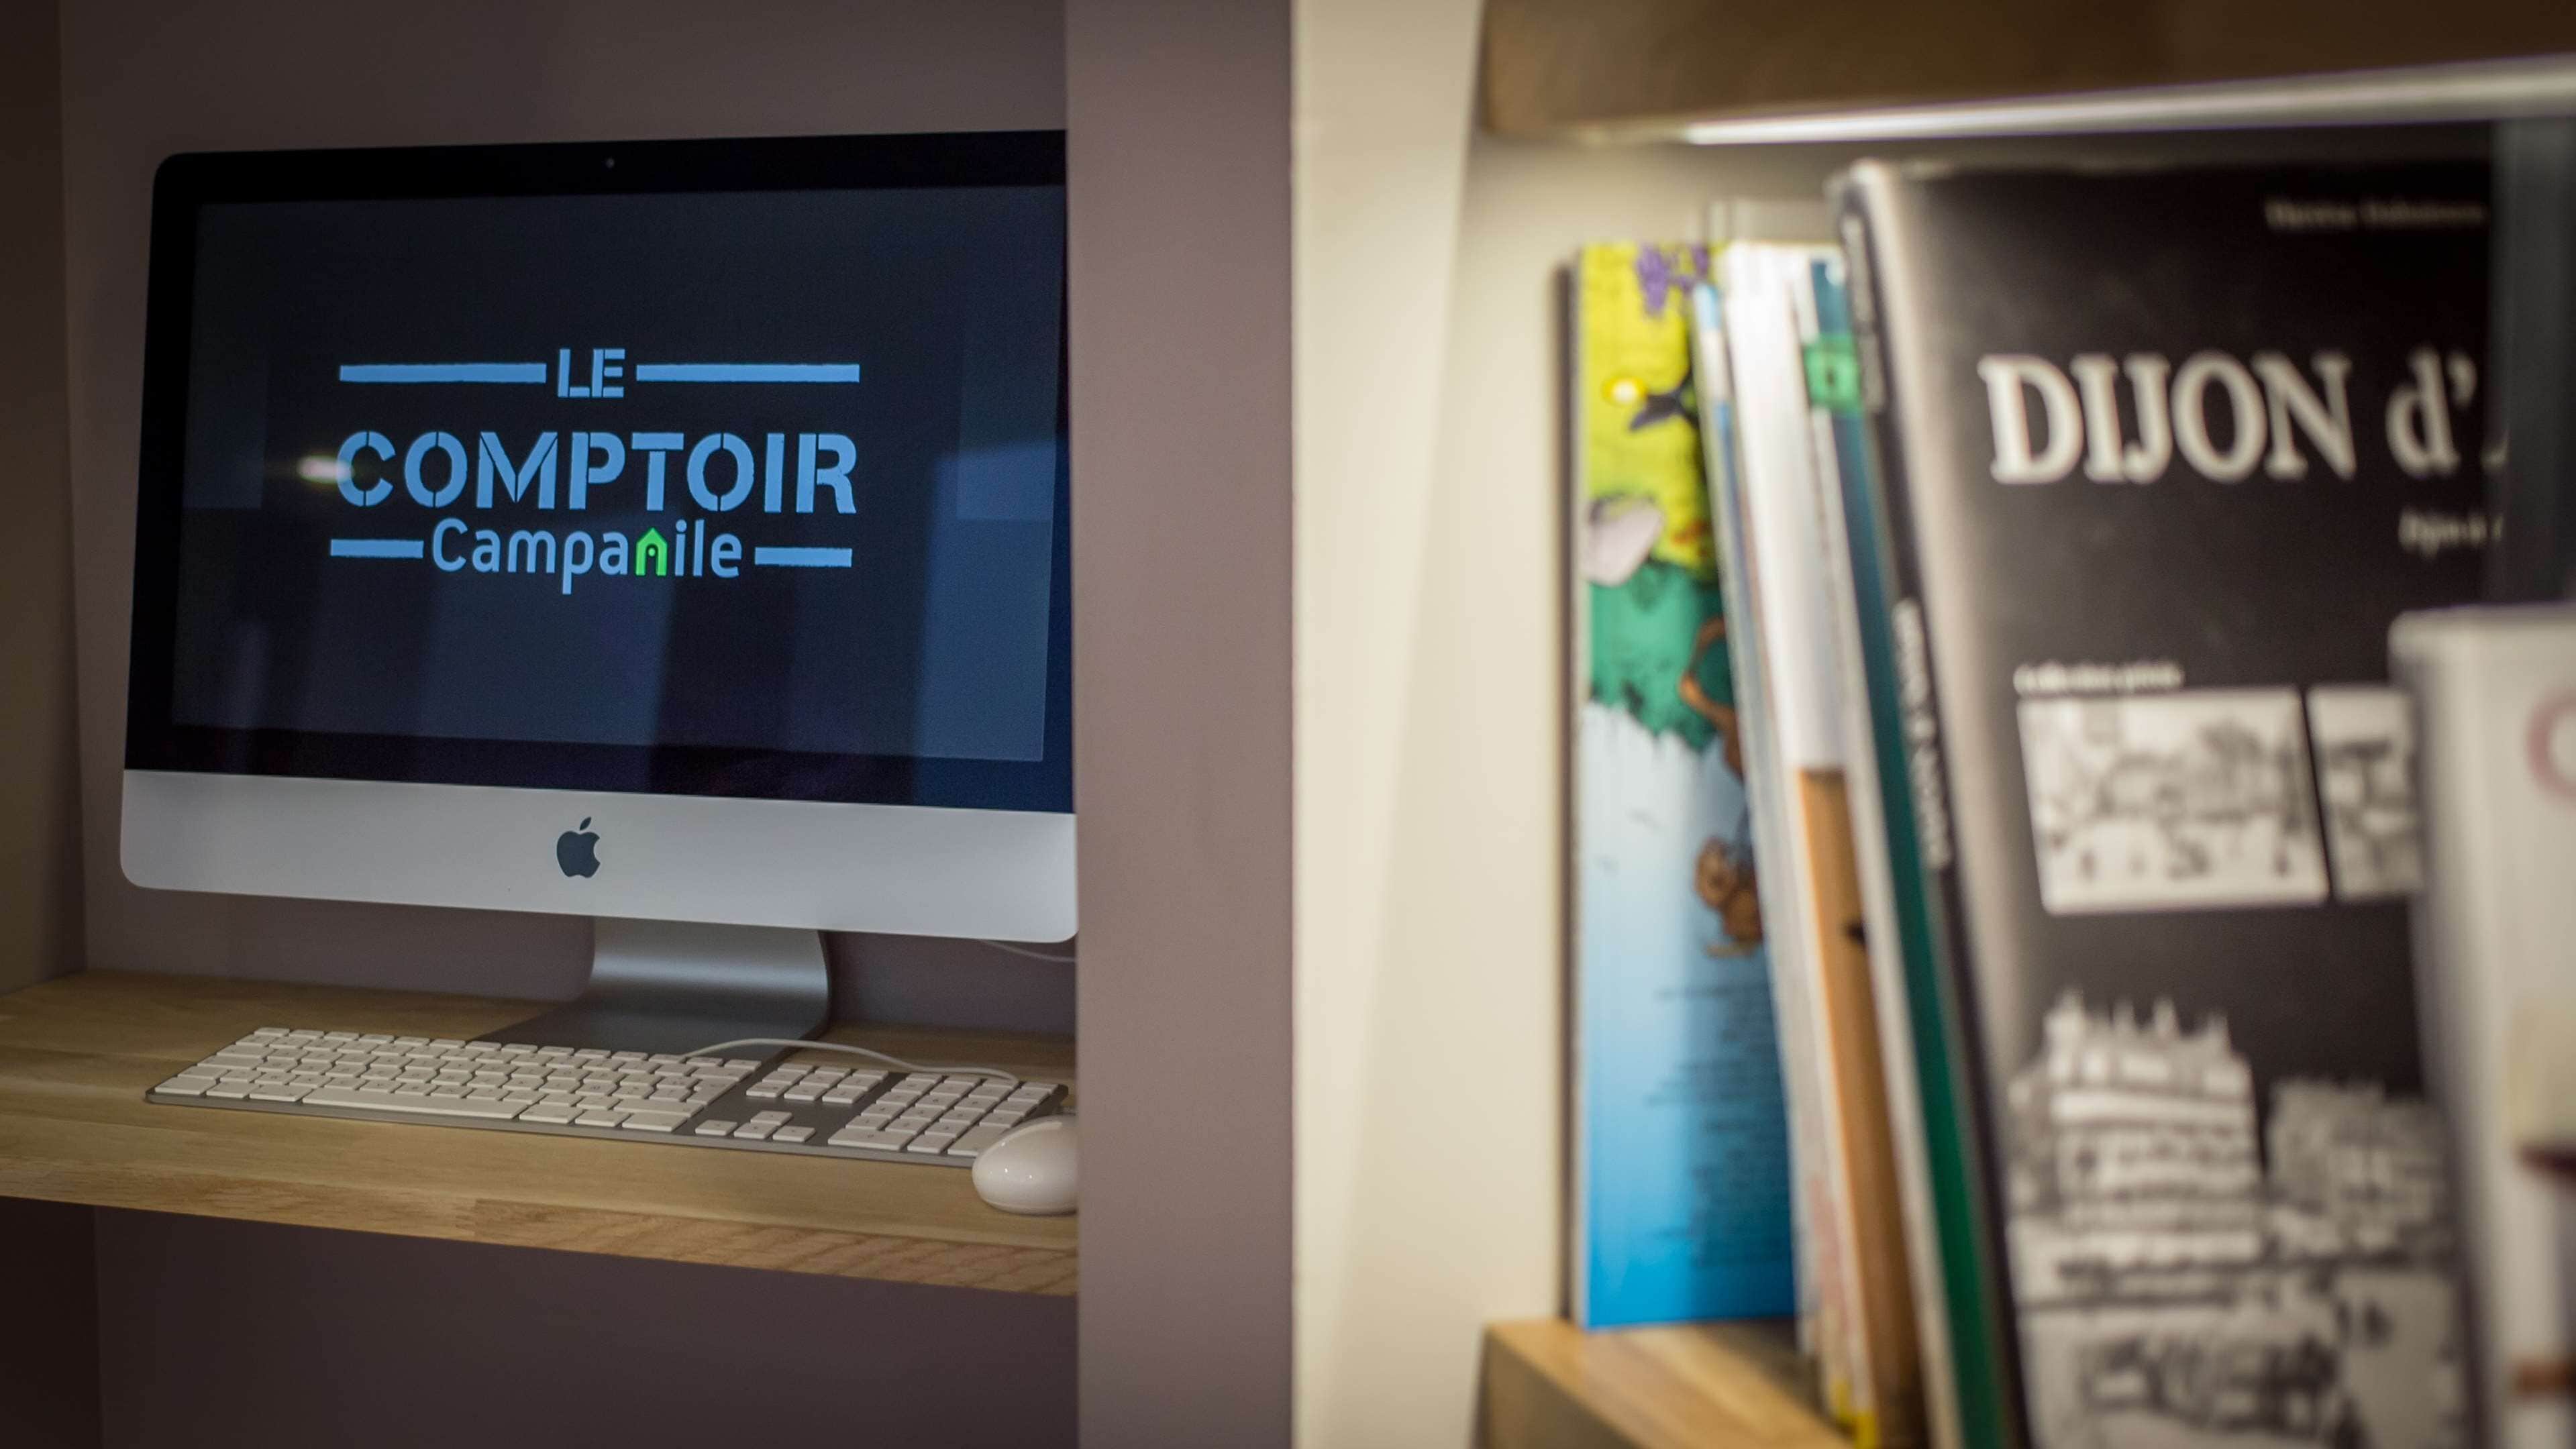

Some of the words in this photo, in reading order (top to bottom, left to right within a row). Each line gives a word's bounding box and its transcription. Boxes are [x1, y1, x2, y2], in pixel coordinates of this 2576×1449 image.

[558, 347, 626, 398] LE
[1976, 352, 2357, 484] DIJON
[2385, 346, 2510, 479] d'
[336, 431, 857, 515] COMPTOIR
[431, 517, 743, 596] Campanile
